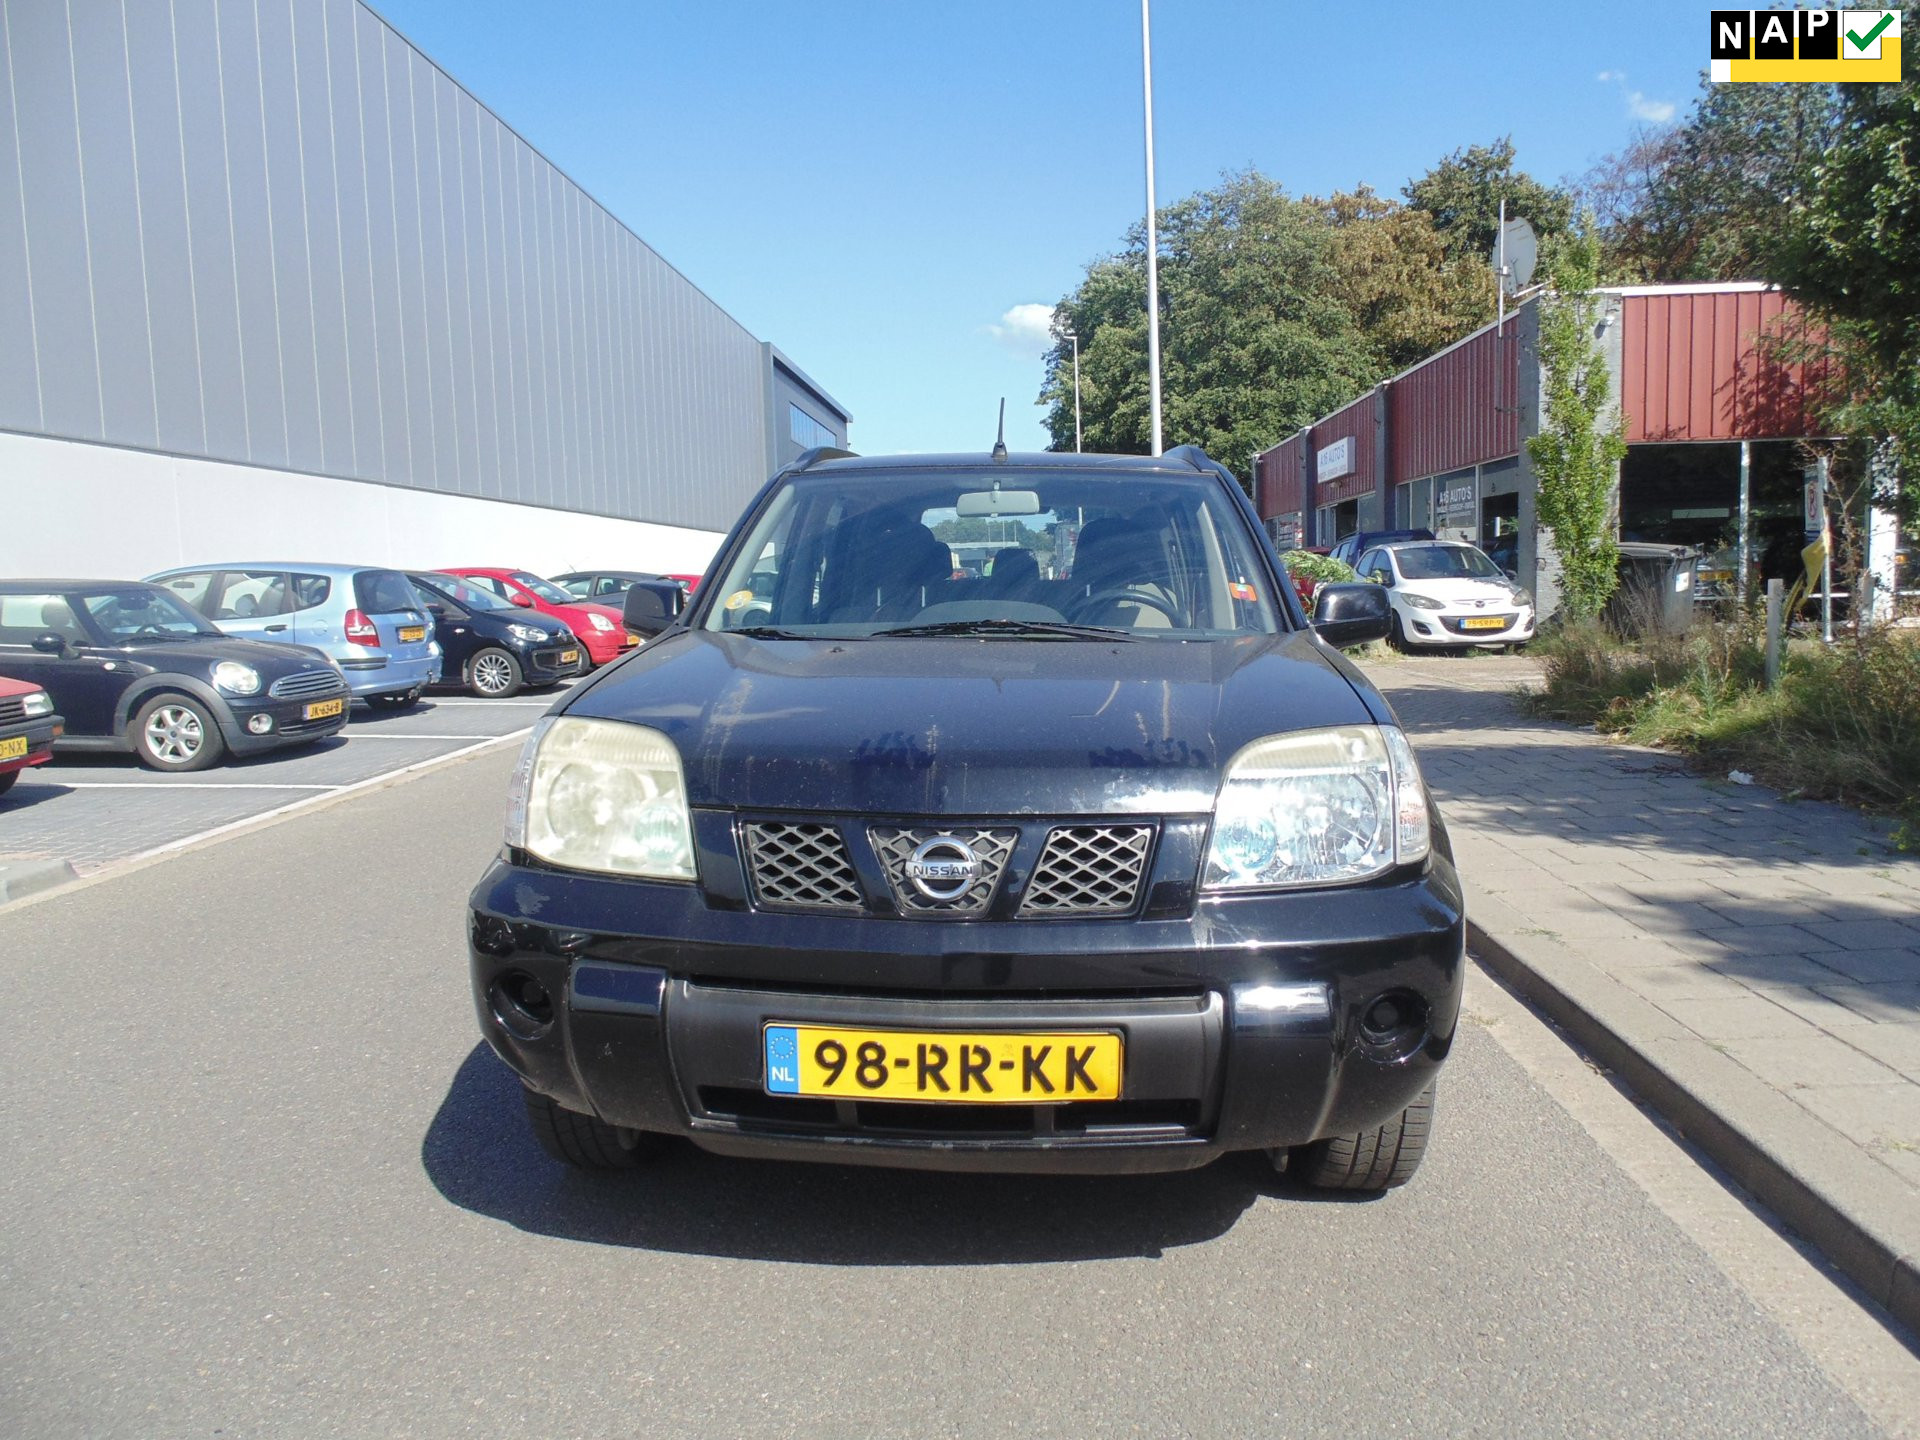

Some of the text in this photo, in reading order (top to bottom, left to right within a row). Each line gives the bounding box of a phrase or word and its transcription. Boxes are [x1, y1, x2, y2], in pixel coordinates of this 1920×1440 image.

[1450, 485, 1472, 503] AUTO'S
[913, 865, 973, 876] NISSAN
[772, 1066, 794, 1082] NL
[814, 1039, 1098, 1093] 98-RR-KK
